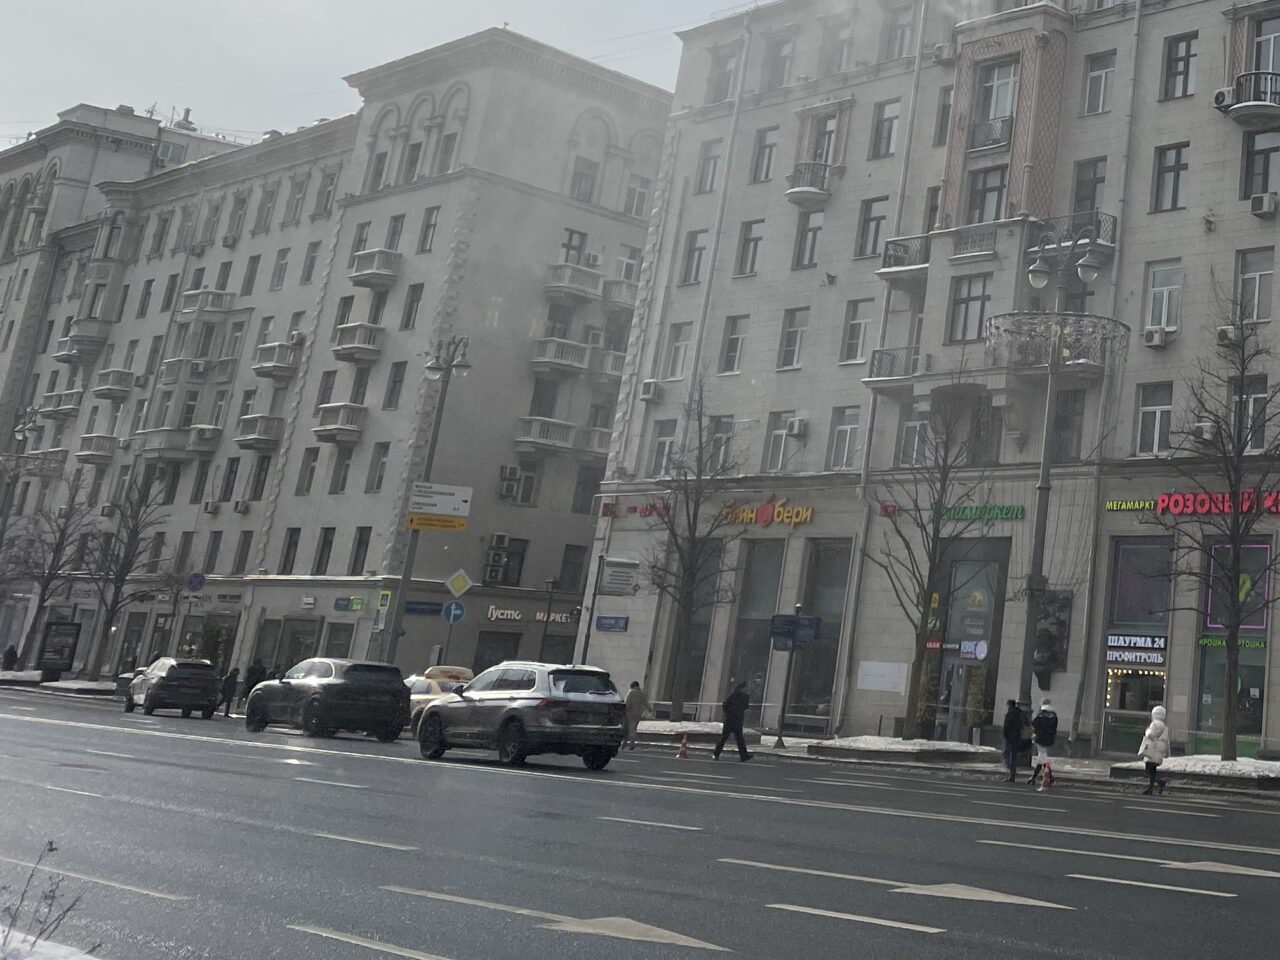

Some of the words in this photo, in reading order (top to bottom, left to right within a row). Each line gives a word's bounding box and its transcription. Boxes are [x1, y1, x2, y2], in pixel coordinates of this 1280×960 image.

[1107, 635, 1151, 648] ШАУРМА
[1153, 638, 1165, 648] 24
[1106, 651, 1164, 664] ПРОФИТРОЛЬ
